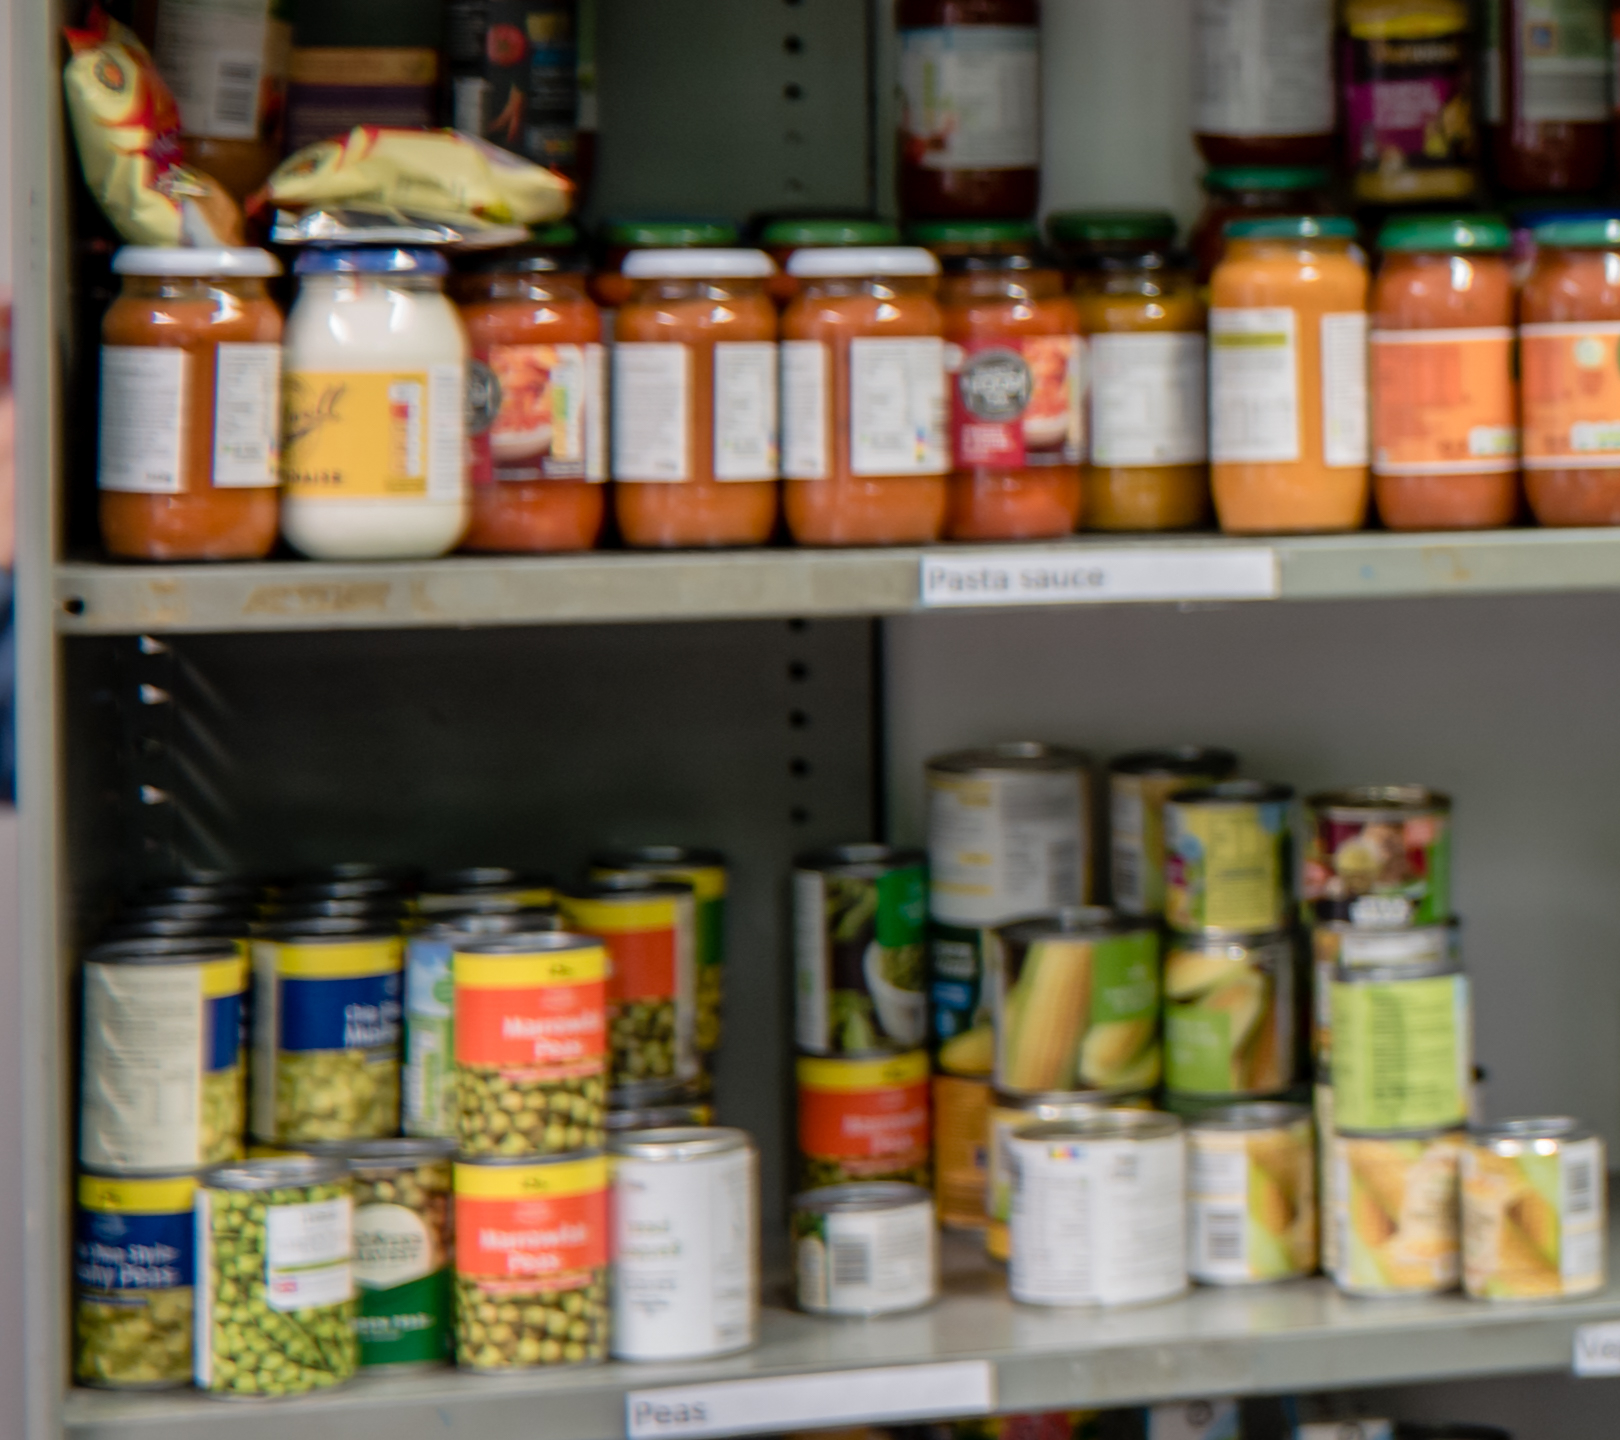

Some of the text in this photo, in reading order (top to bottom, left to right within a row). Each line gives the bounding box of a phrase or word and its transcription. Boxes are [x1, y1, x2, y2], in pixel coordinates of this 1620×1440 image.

[927, 567, 1129, 593] Pasta sauce
[633, 1400, 707, 1427] Peas
